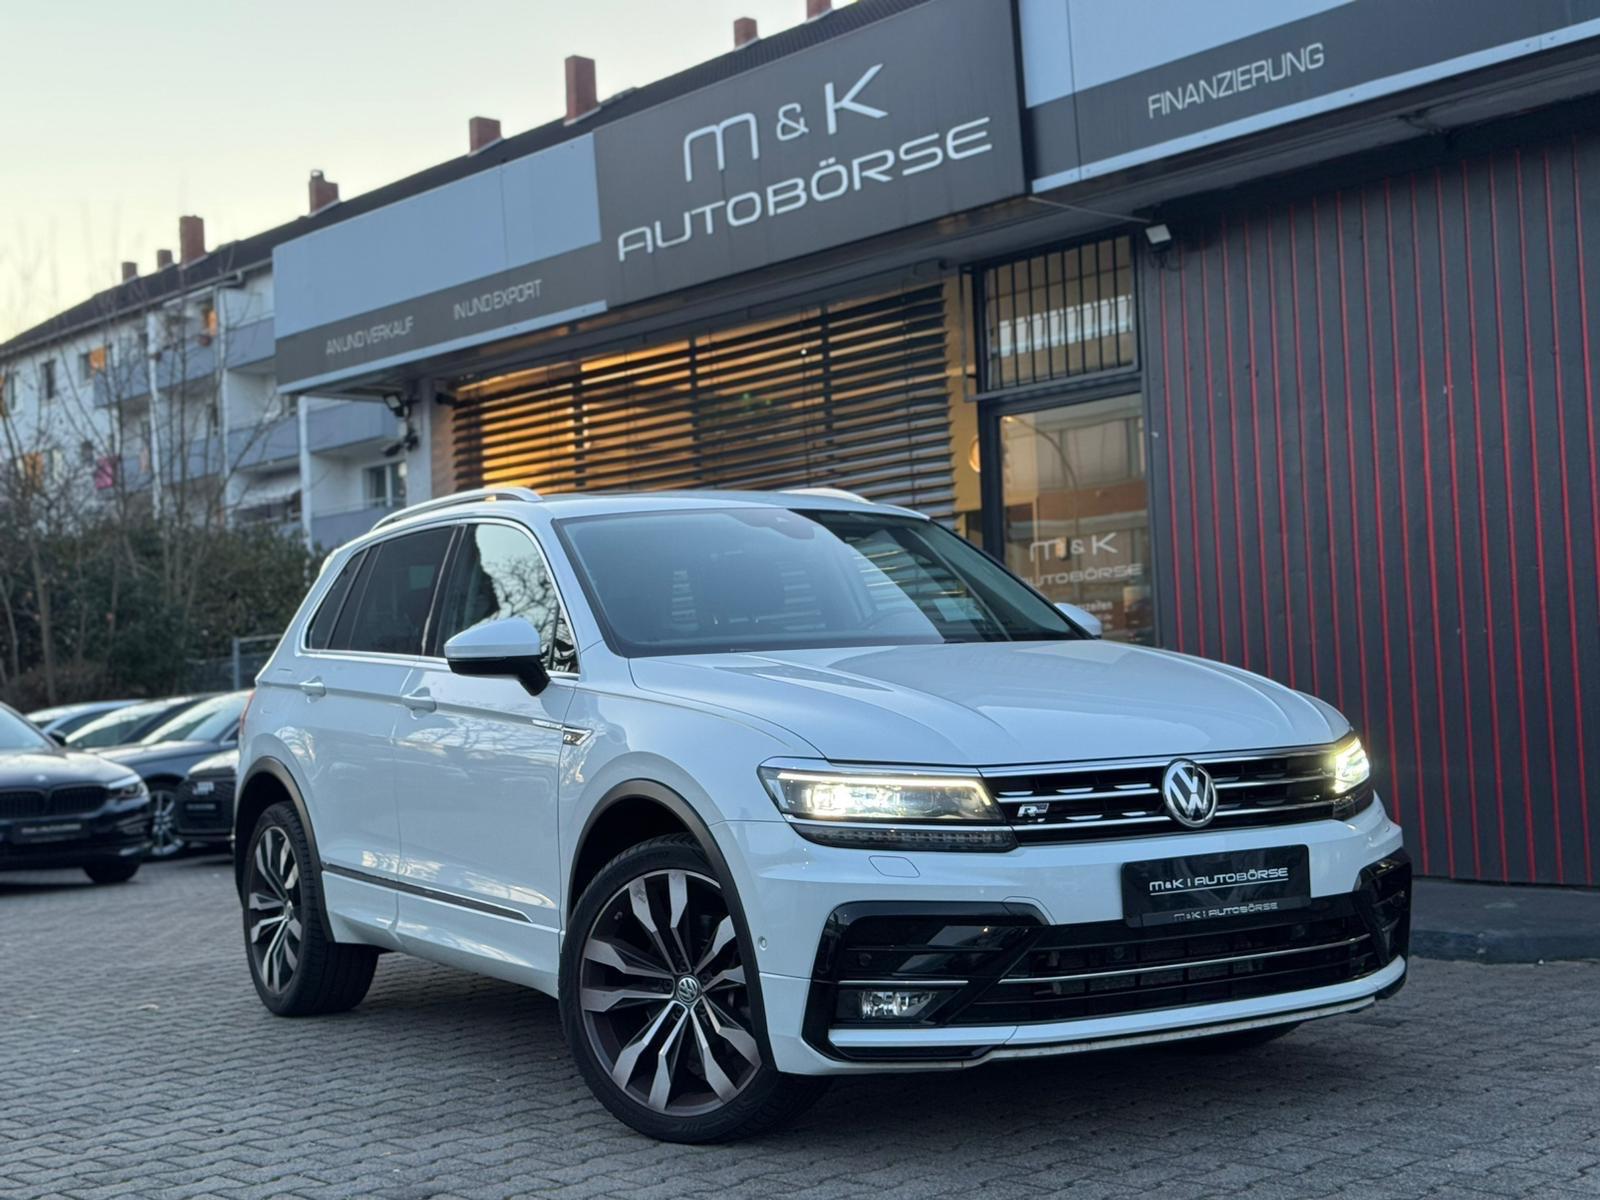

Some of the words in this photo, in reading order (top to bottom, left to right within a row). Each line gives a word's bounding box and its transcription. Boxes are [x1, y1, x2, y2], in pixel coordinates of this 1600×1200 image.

[776, 103, 809, 142] &
[824, 63, 889, 136] K
[1147, 42, 1325, 119] FINANZIERUNG
[617, 116, 993, 262] AUTOBÖRSE
[1091, 531, 1119, 556] K
[1194, 867, 1289, 886] AUTOBÖRSE
[1208, 902, 1279, 917] AUTOBÖRSE
